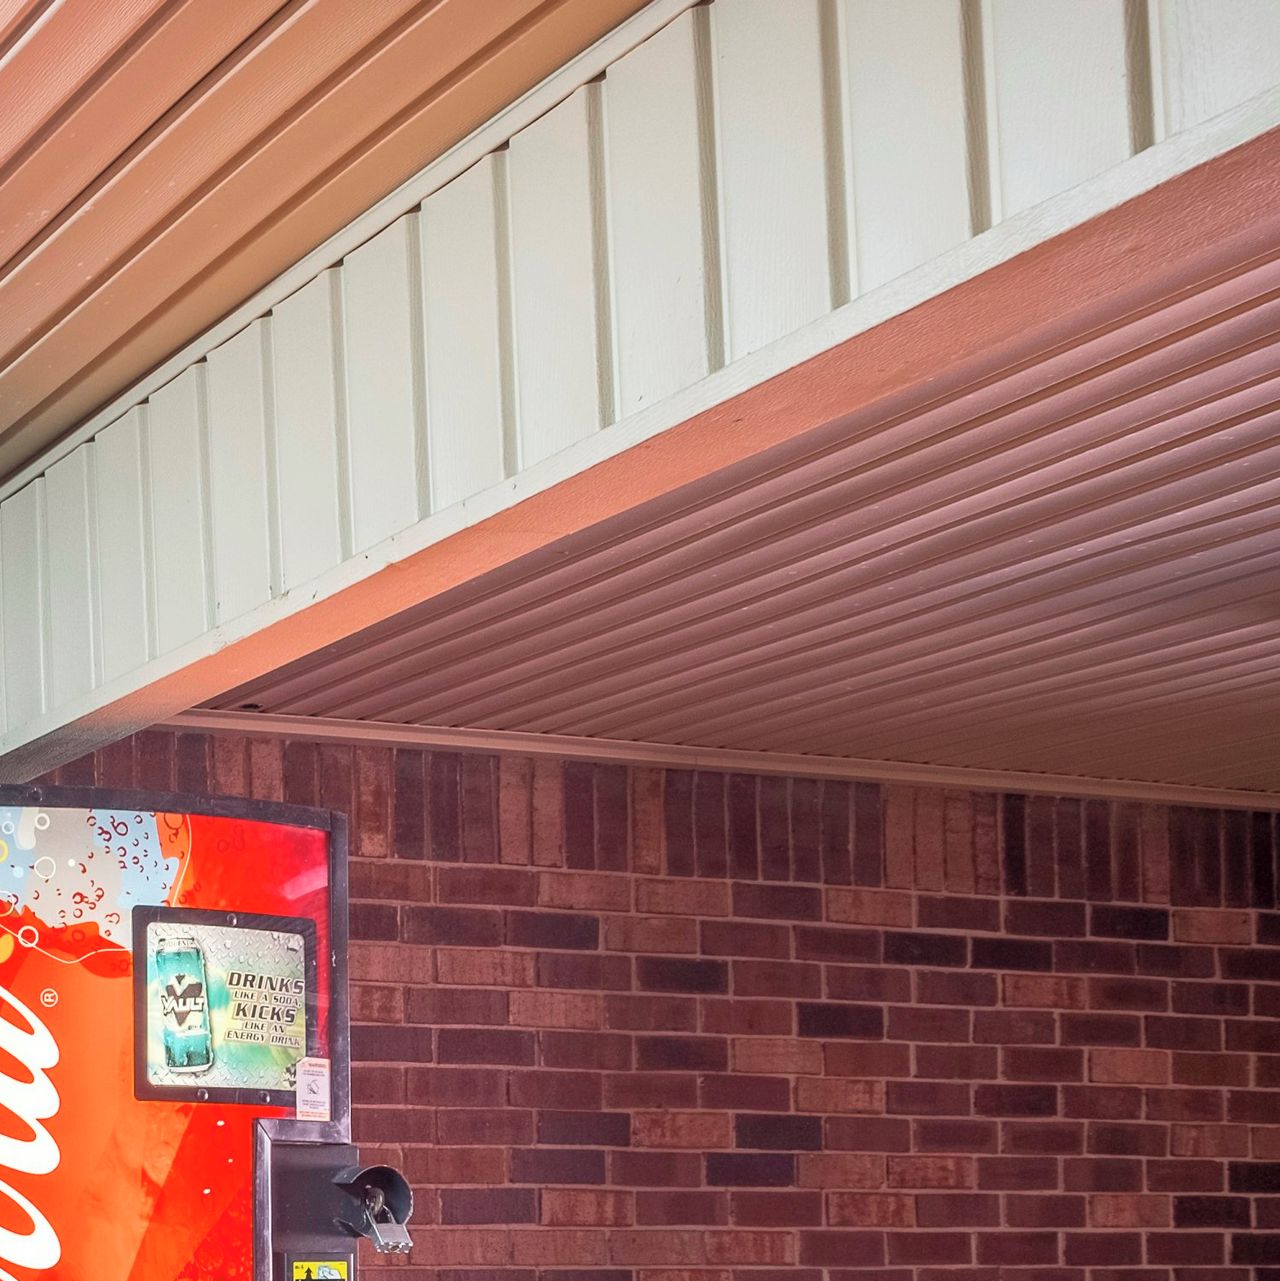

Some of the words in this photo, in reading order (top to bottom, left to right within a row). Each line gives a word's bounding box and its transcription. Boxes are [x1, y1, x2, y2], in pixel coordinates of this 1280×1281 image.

[228, 972, 305, 994] DRINKS
[161, 995, 205, 1016] VAULT
[234, 990, 255, 1000] LIKE
[273, 995, 301, 1007] SODA,
[235, 1002, 296, 1023] KICKS
[244, 1021, 265, 1031] LIKE
[271, 1024, 284, 1033] AN
[227, 1030, 265, 1042] ENERGY
[271, 1035, 300, 1046] DRINK
